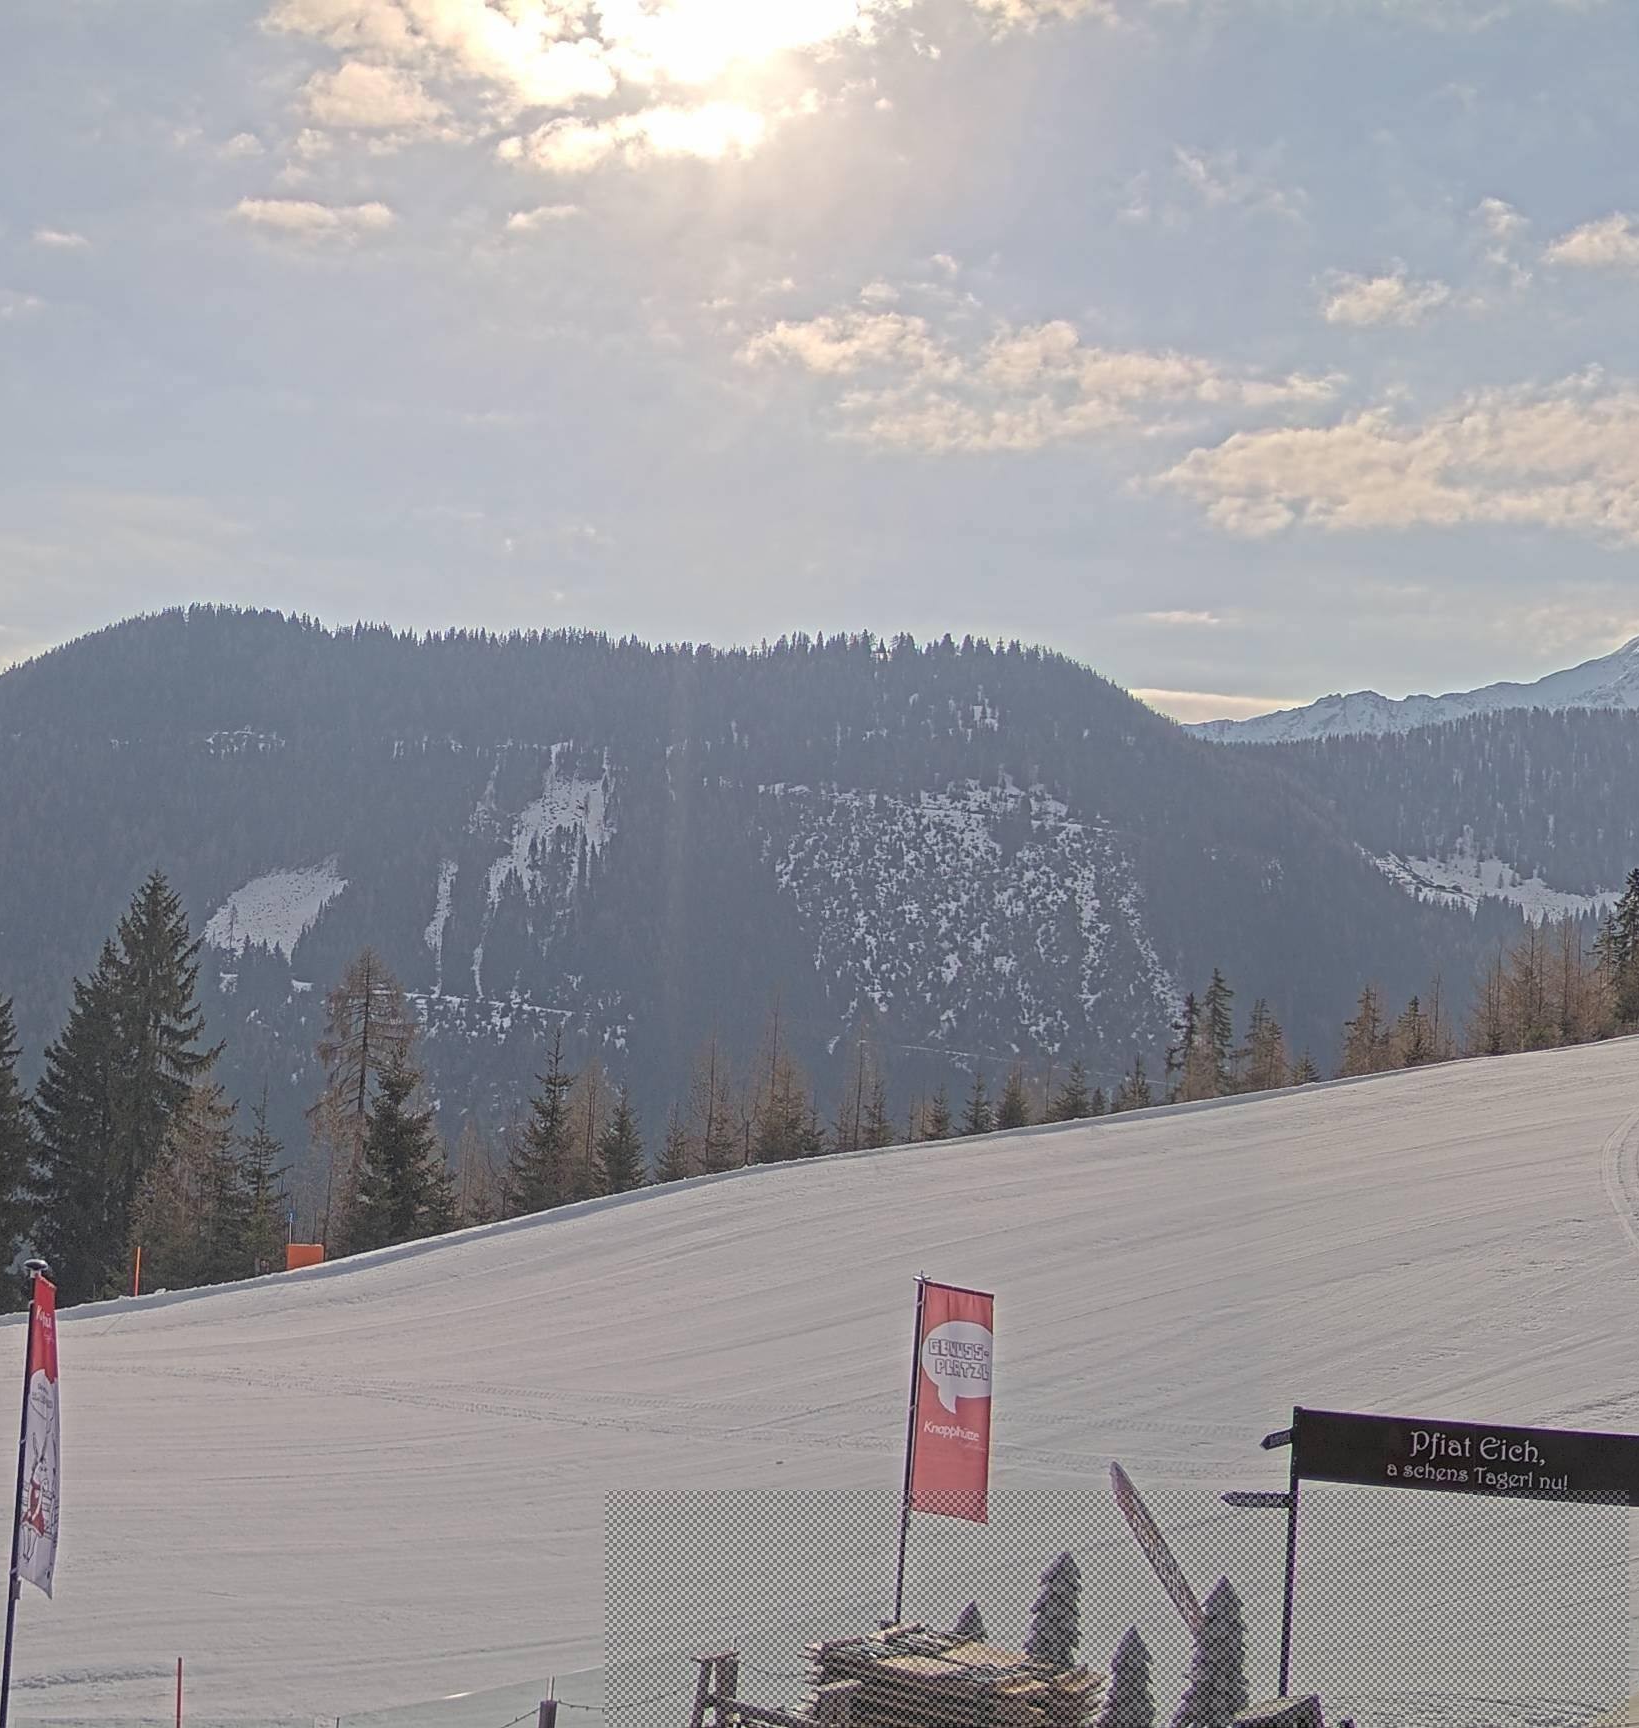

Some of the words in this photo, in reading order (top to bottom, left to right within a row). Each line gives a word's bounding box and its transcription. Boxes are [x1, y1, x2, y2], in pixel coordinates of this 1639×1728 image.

[1410, 1430, 1471, 1460] Pfiat
[1479, 1437, 1546, 1466] Eich,
[1387, 1463, 1398, 1477] a
[1403, 1462, 1469, 1483] schens
[1473, 1467, 1533, 1489] Tagerl
[1539, 1475, 1569, 1491] nu!
